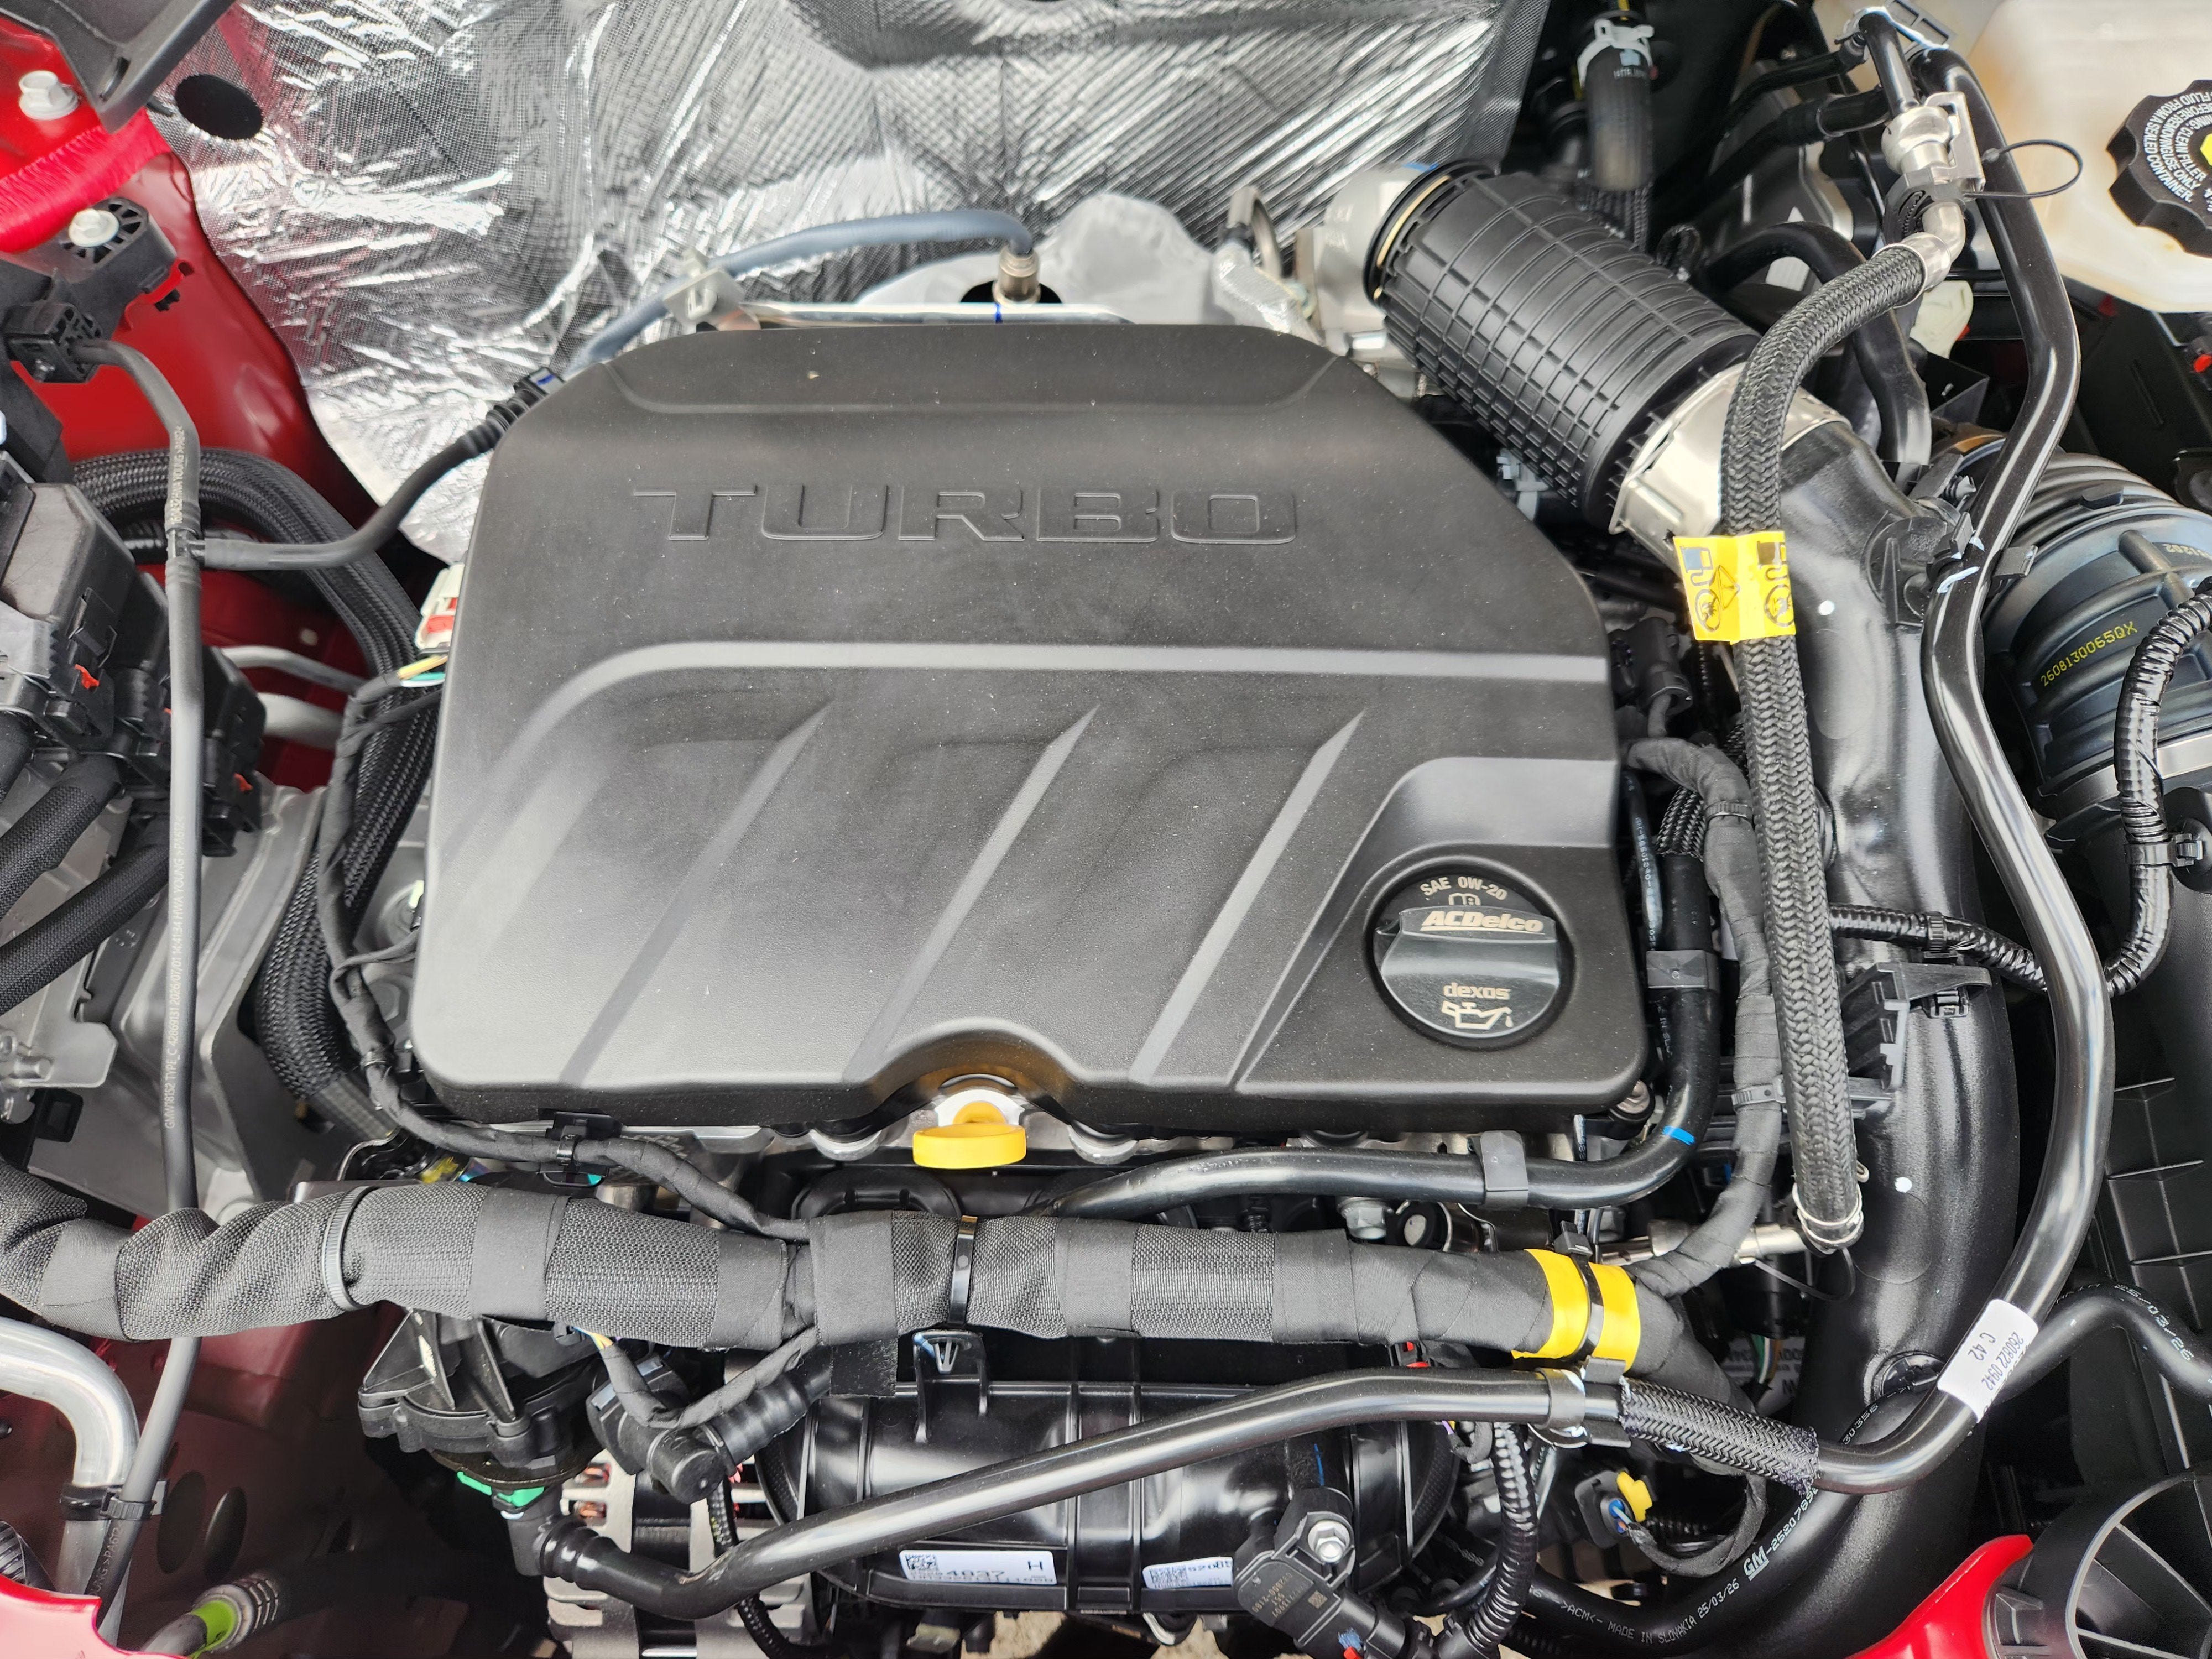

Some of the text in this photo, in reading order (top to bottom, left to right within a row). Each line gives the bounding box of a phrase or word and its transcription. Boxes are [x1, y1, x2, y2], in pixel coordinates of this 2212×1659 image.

[2152, 98, 2183, 121] FROM
[2143, 122, 2159, 153] SEALED
[2175, 127, 2193, 154] CLEAN
[2173, 168, 2201, 190] ONLY
[2178, 153, 2207, 181] FILLER
[633, 485, 1295, 545] TURBO
[173, 858, 184, 893] YOUNG
[1420, 876, 1507, 901] SAE 0W-20
[173, 896, 184, 920] HWA
[1421, 910, 1544, 933] ACDelco
[1443, 982, 1511, 1000] dexos
[1968, 1332, 1996, 1361] C 42
[1996, 1331, 2024, 1369] 260822
[1981, 1364, 2003, 1391] 0942
[1608, 1621, 1635, 1639] MADE
[1641, 1631, 1652, 1644] IN
[1658, 1615, 1697, 1644] SLOVAKIA
[1698, 1578, 1740, 1619] 25/03/26
